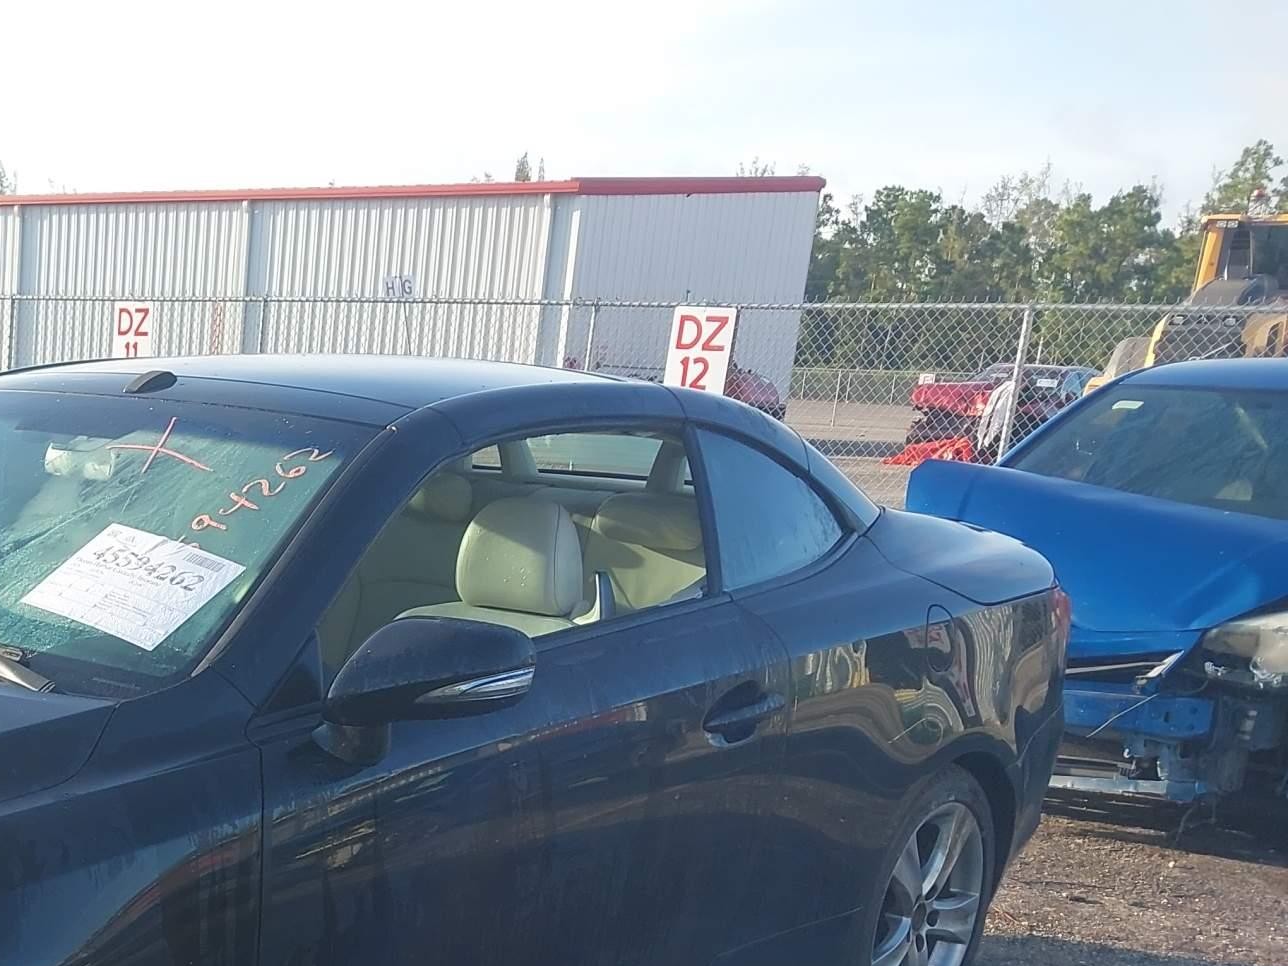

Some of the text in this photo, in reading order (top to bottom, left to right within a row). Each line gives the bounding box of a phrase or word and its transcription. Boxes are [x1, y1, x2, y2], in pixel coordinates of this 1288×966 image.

[118, 308, 149, 336] DZ
[676, 315, 729, 351] DZ
[124, 341, 138, 358] 11
[680, 356, 709, 391] 12
